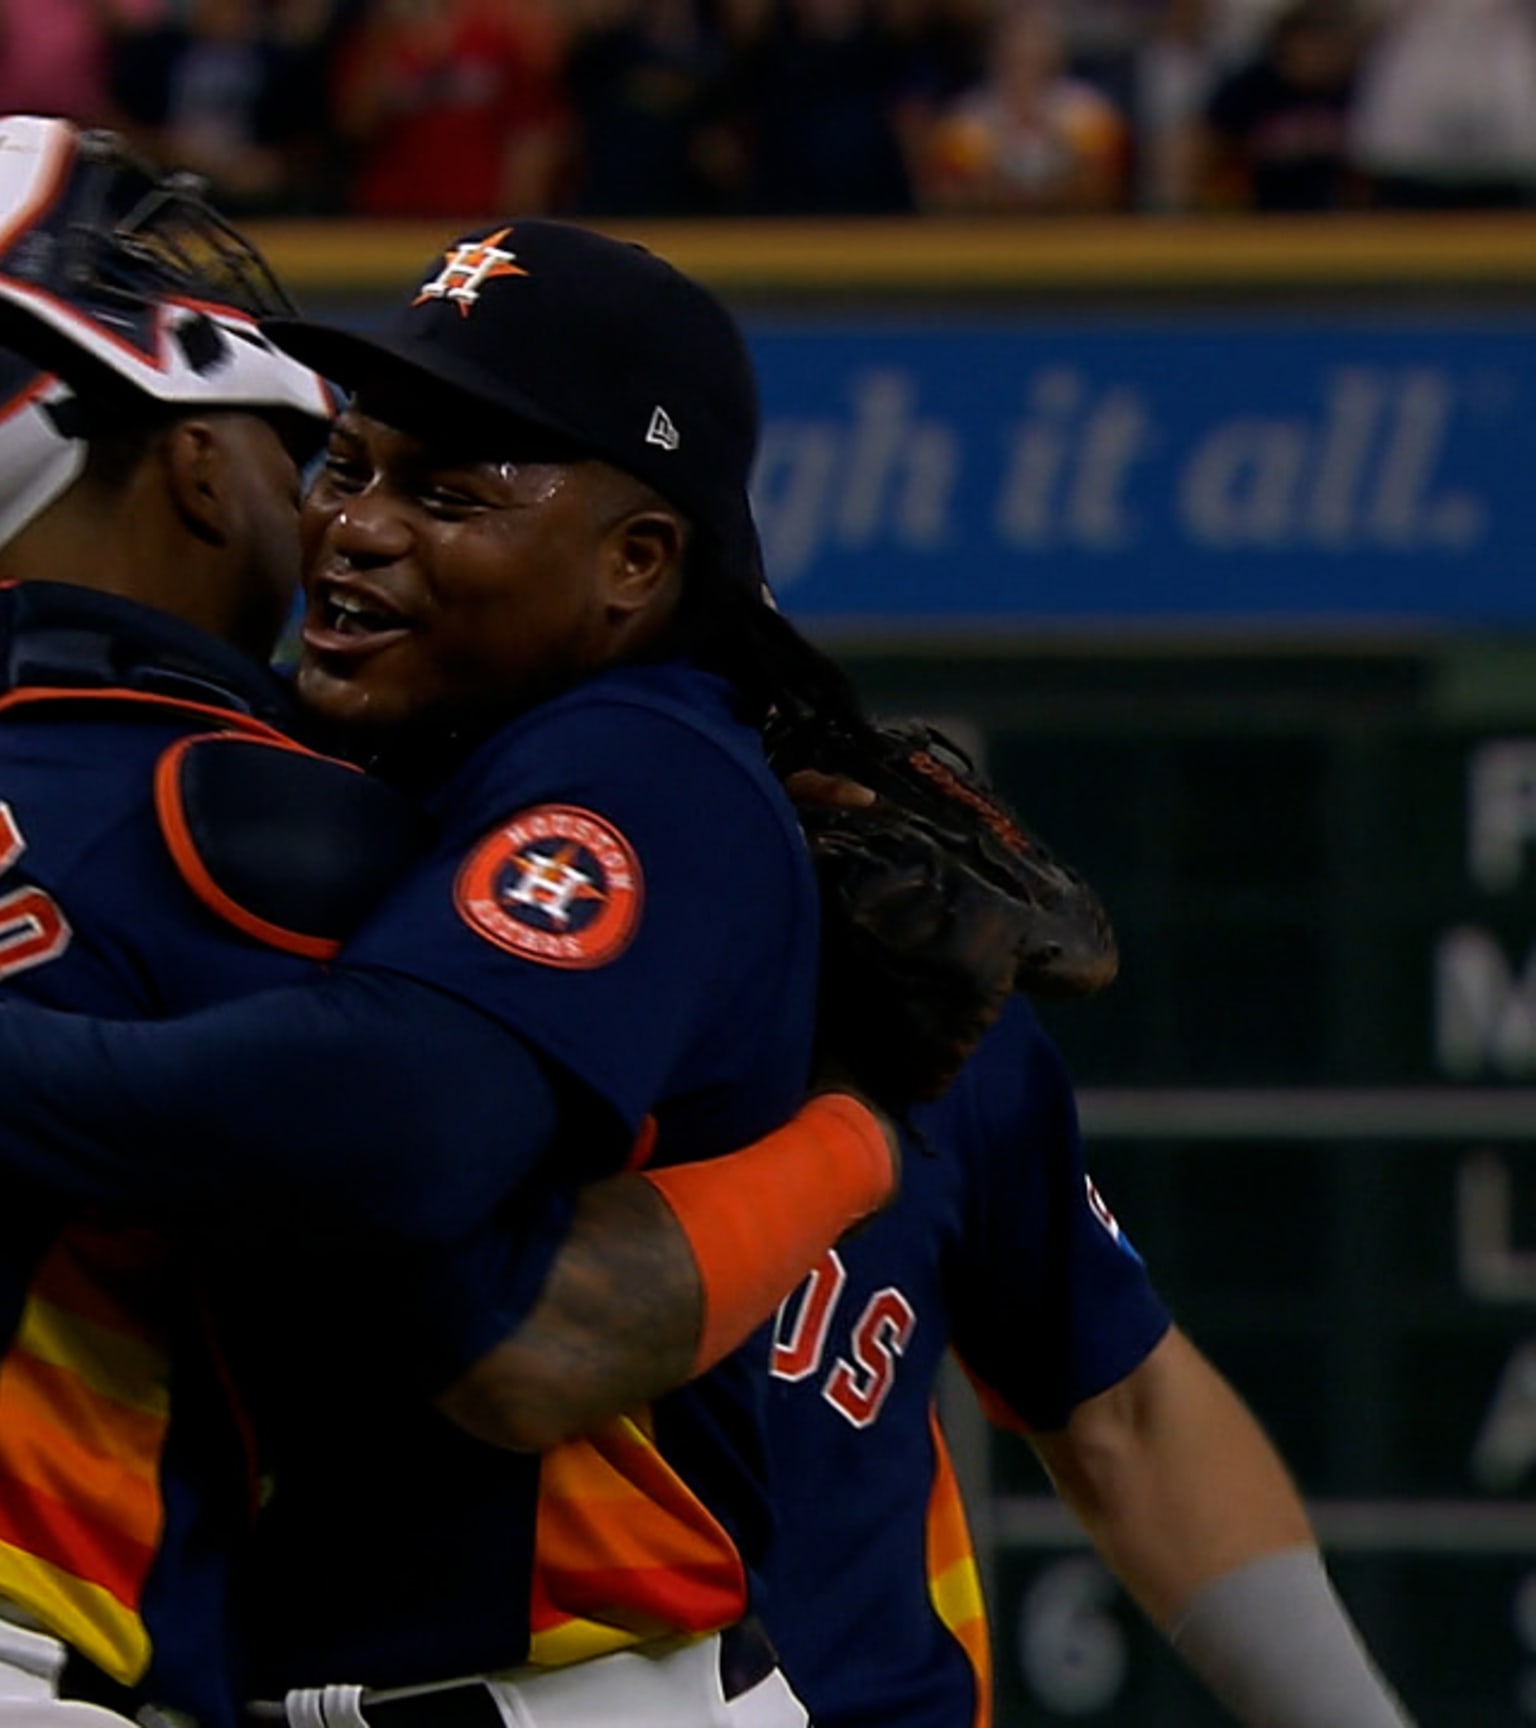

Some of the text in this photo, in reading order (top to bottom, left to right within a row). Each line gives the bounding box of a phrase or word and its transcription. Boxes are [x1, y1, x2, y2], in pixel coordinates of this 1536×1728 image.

[420, 241, 517, 301] H
[994, 364, 1152, 551] it
[1174, 364, 1486, 551] all.
[1020, 1555, 1130, 1719] 6
